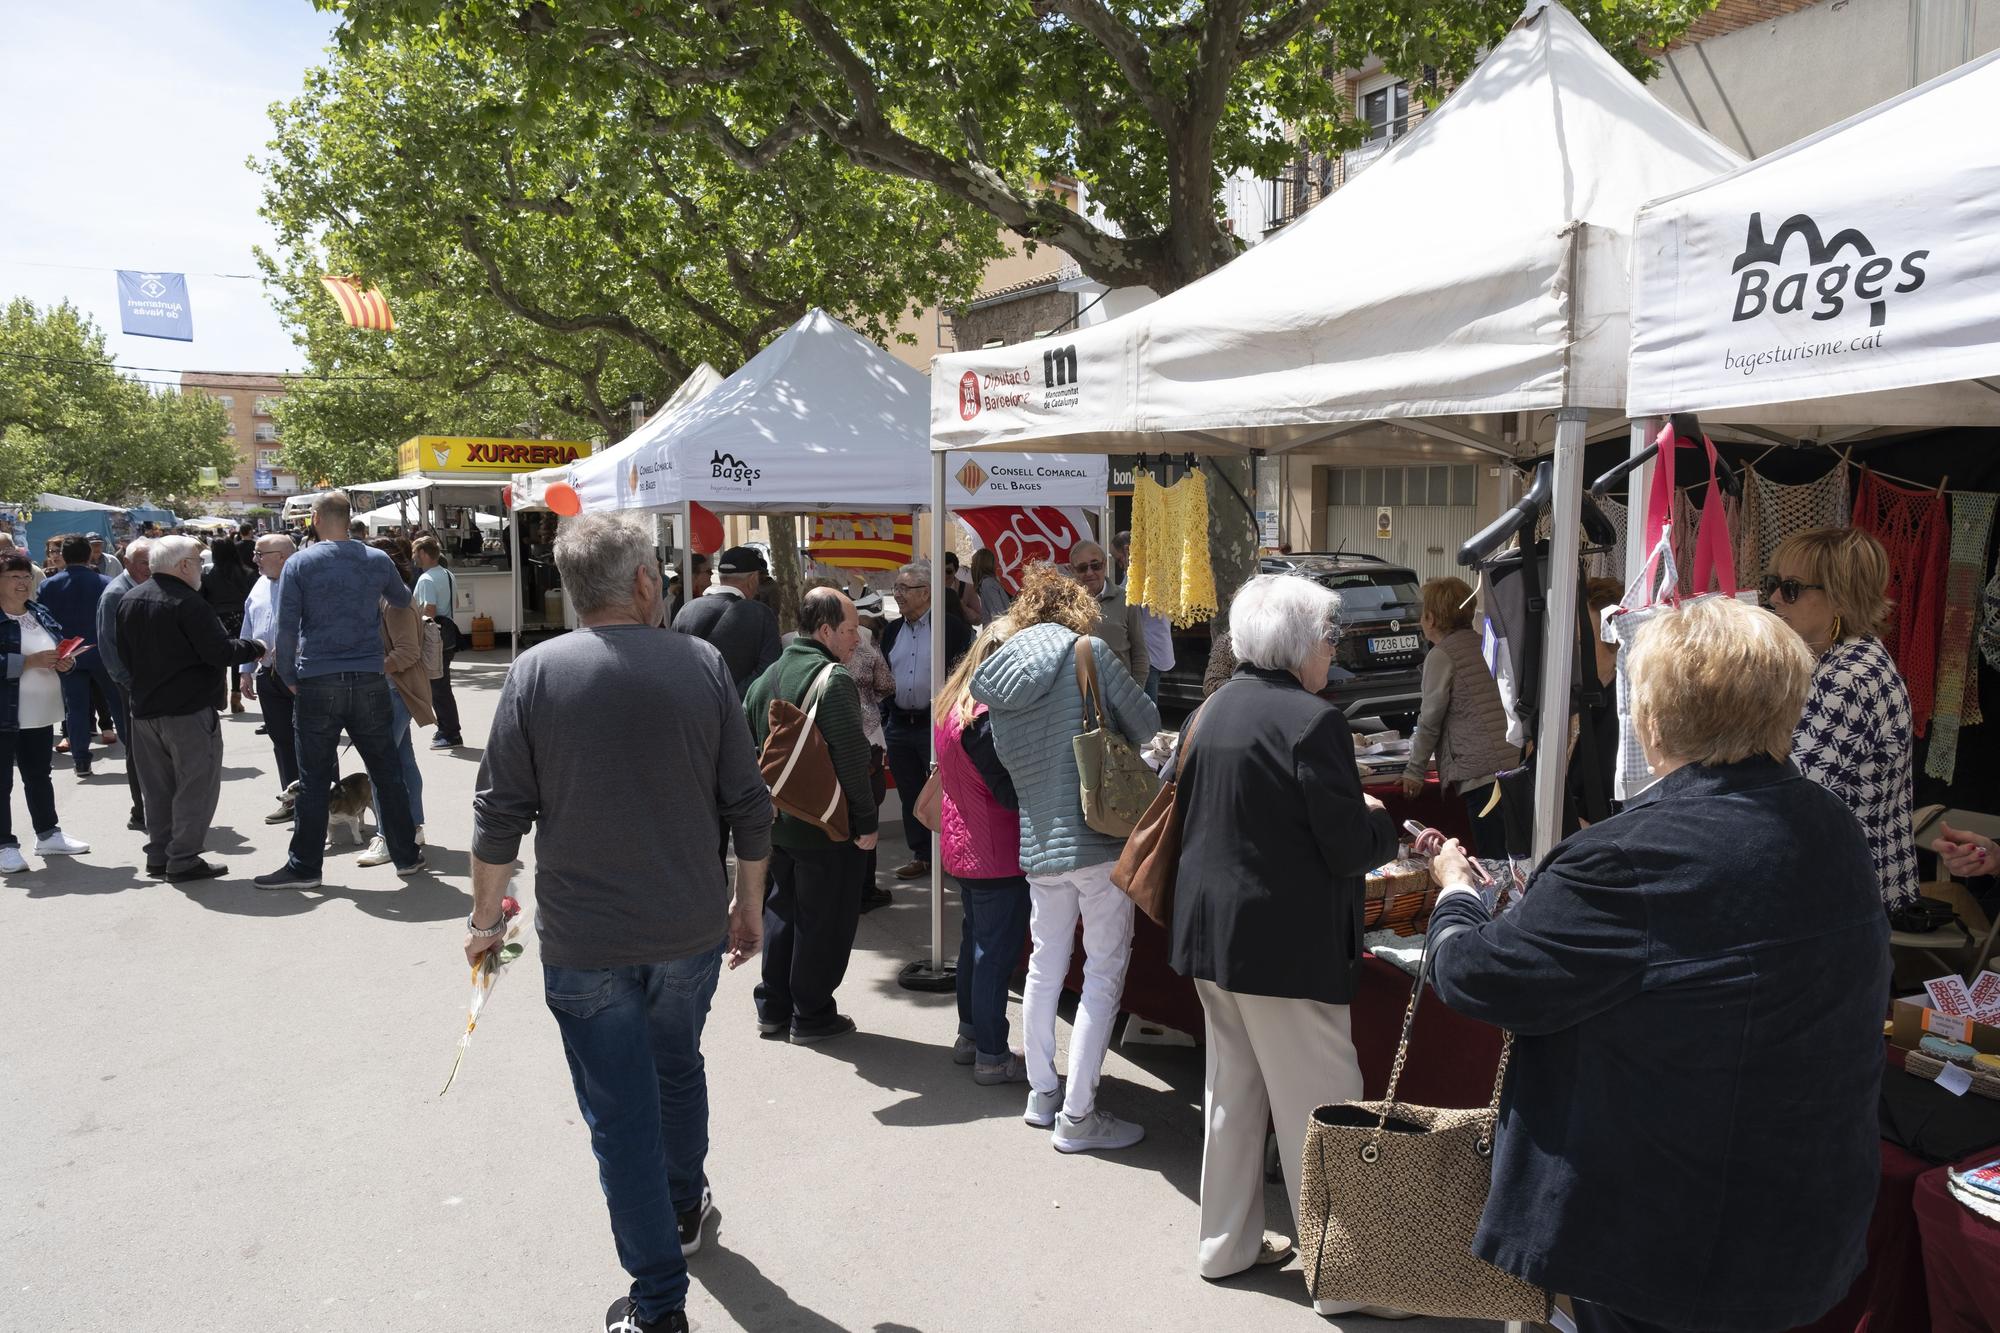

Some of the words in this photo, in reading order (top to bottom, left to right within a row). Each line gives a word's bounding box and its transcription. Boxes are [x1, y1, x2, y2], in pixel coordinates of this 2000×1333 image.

[1732, 249, 1930, 322] Bages
[1724, 330, 1883, 375] bagesturisme.cat
[984, 366, 1030, 390] Diputacó
[1045, 387, 1079, 399] Mancomunitat
[1043, 401, 1051, 409] de
[1051, 396, 1079, 409] Catalunya
[467, 443, 580, 465] XURRERIA
[712, 464, 761, 482] Bages
[991, 465, 1034, 477] CONSELL
[1036, 466, 1087, 478] COMARCAL
[991, 482, 1008, 490] DEL
[1010, 481, 1042, 490] BAGES
[1374, 638, 1398, 651] 7236
[1400, 636, 1417, 649] LCZ
